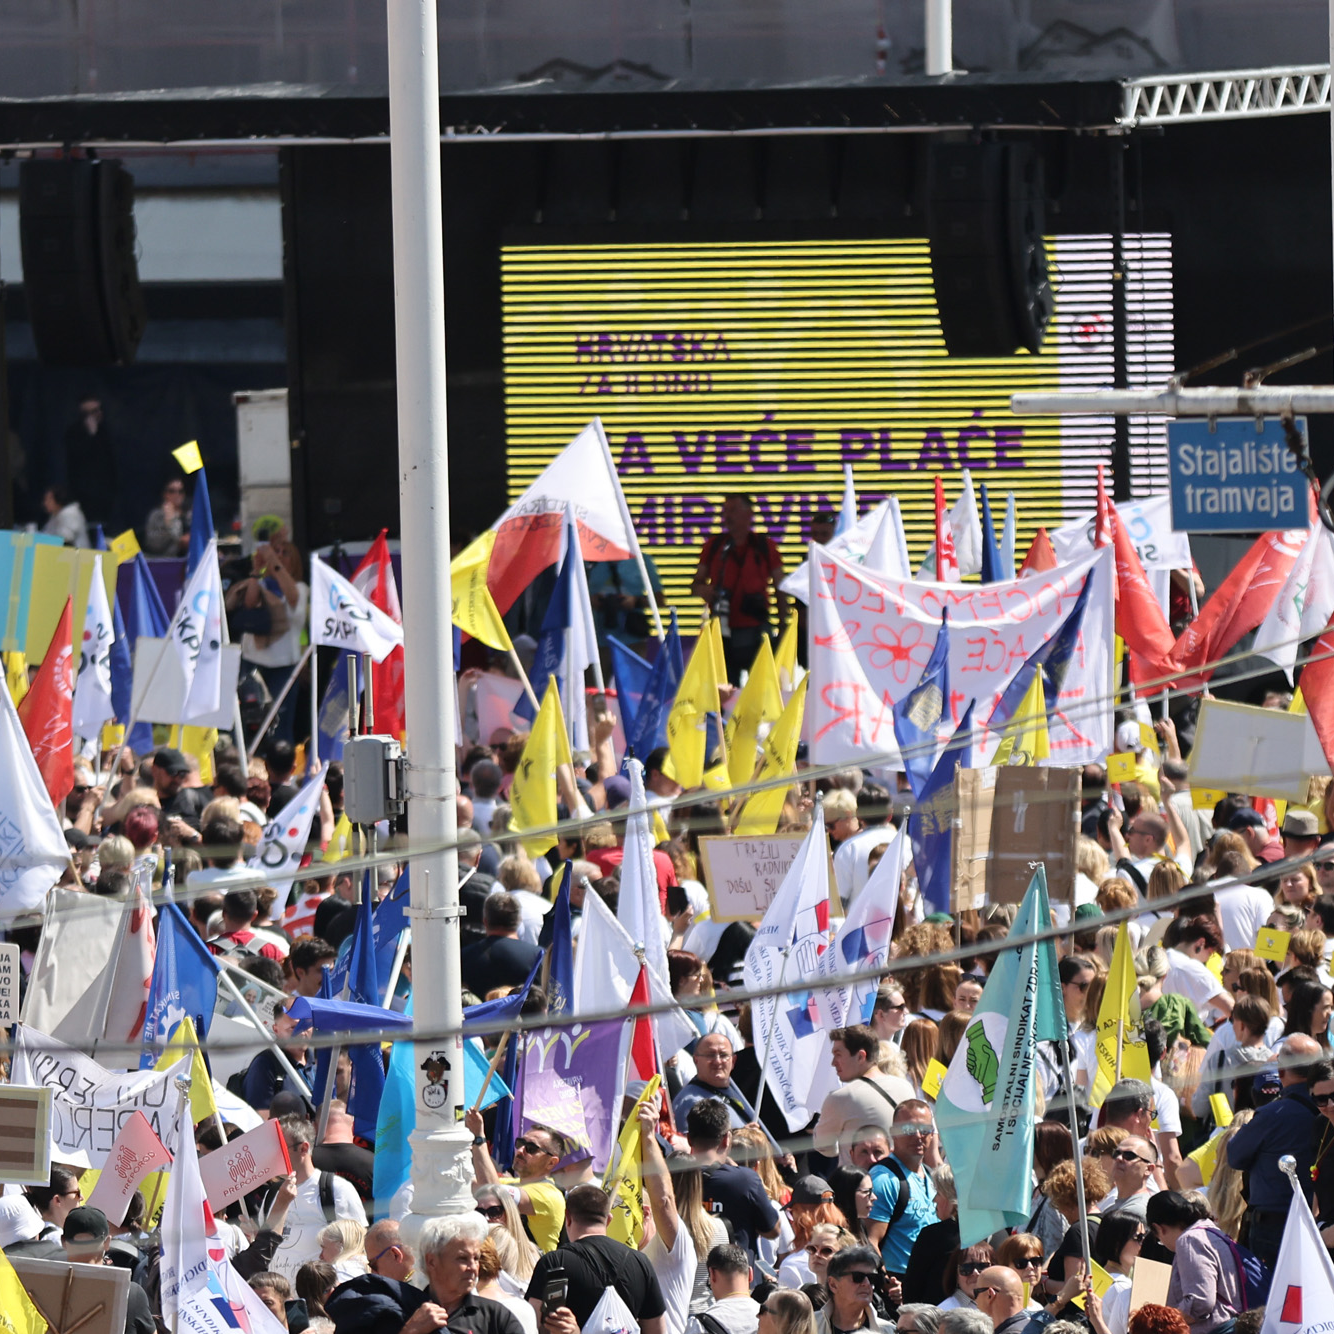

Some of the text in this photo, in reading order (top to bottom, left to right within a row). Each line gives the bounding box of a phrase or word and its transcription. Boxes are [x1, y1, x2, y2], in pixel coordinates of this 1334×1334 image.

[575, 333, 731, 362] HRVATSKA
[839, 408, 1025, 471] PLAĆE
[1178, 441, 1298, 482] Stajalište
[1184, 479, 1295, 518] tramvaja
[764, 878, 777, 893] SU
[769, 1052, 797, 1111] TEHNIČARA
[992, 995, 1034, 1152] SAMOSTALNI SINDIKAT
[1007, 1047, 1035, 1128] SOCIJALNE
[122, 1149, 157, 1196] PREPOROD
[222, 1166, 271, 1198] PREPOROD
